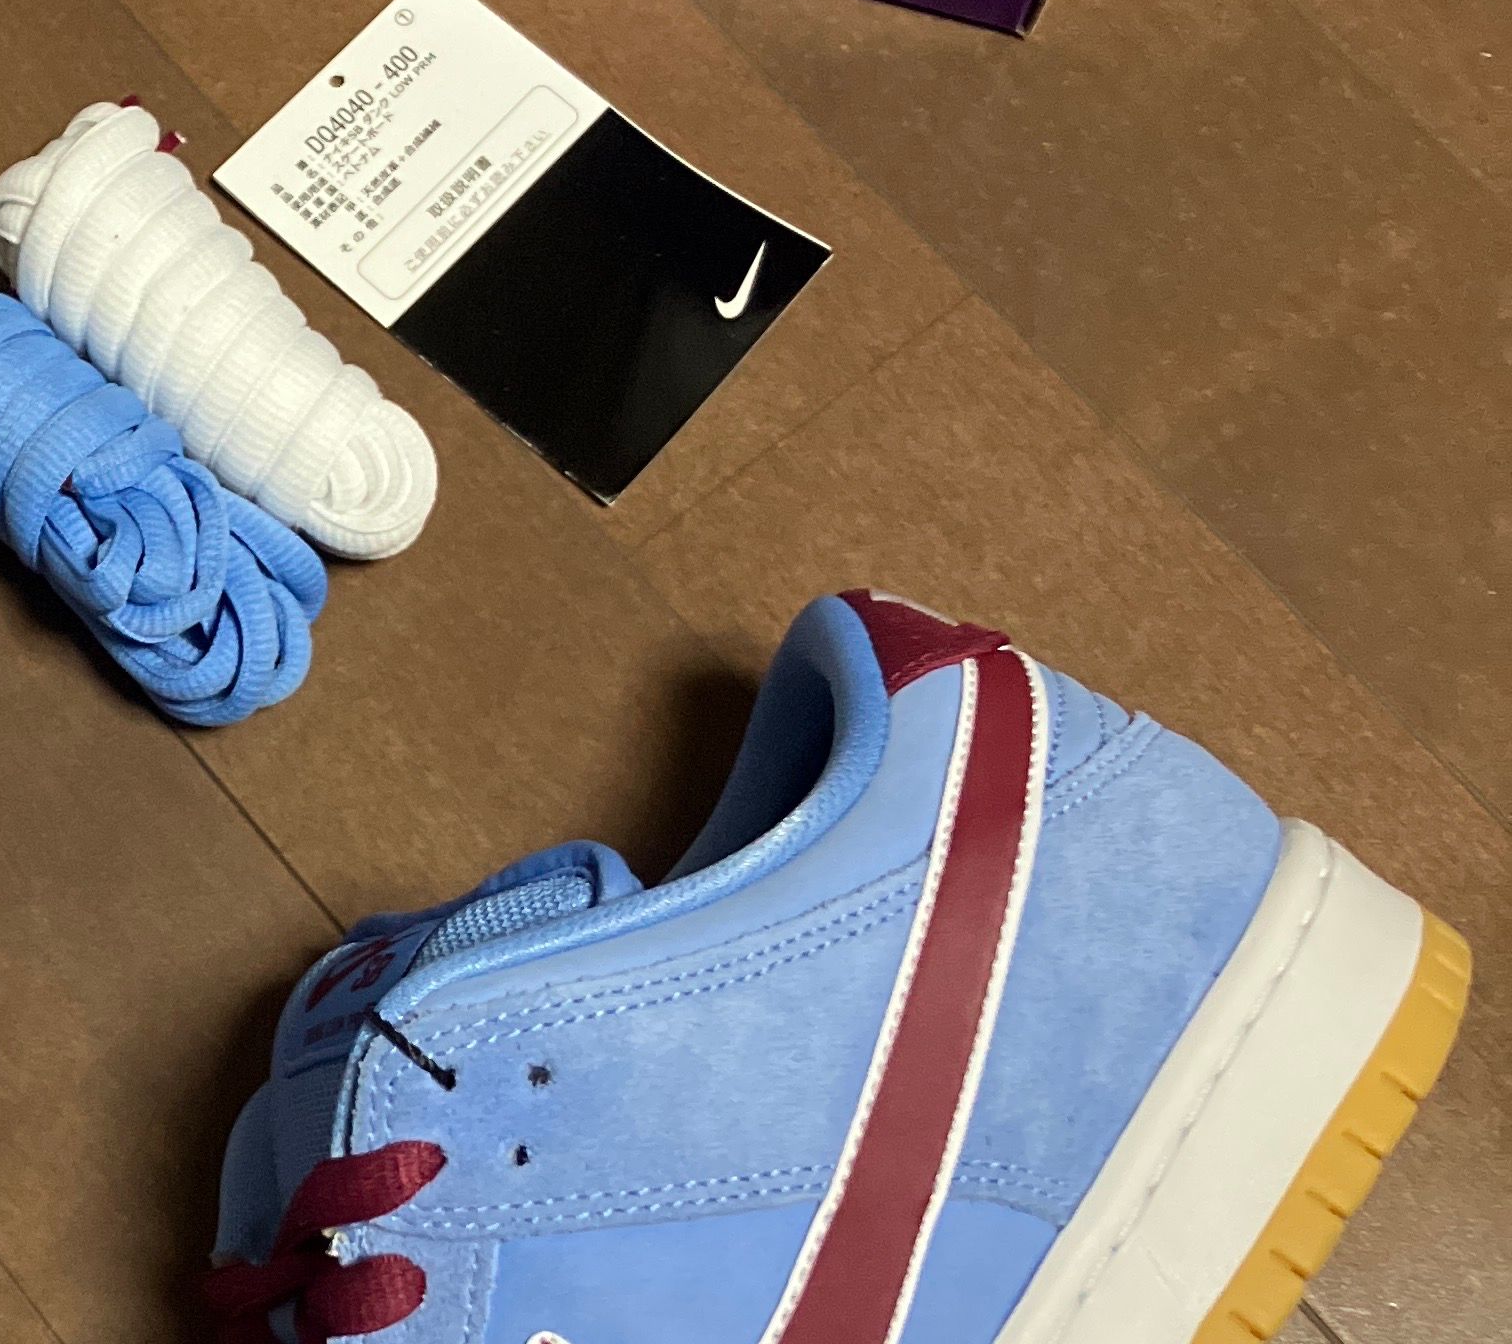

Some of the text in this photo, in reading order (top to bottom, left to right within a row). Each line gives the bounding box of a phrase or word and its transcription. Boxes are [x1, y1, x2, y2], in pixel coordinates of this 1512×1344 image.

[303, 85, 376, 156] DQ4040
[378, 42, 420, 83] 400
[388, 73, 414, 99] LOW
[411, 50, 437, 76] PRM
